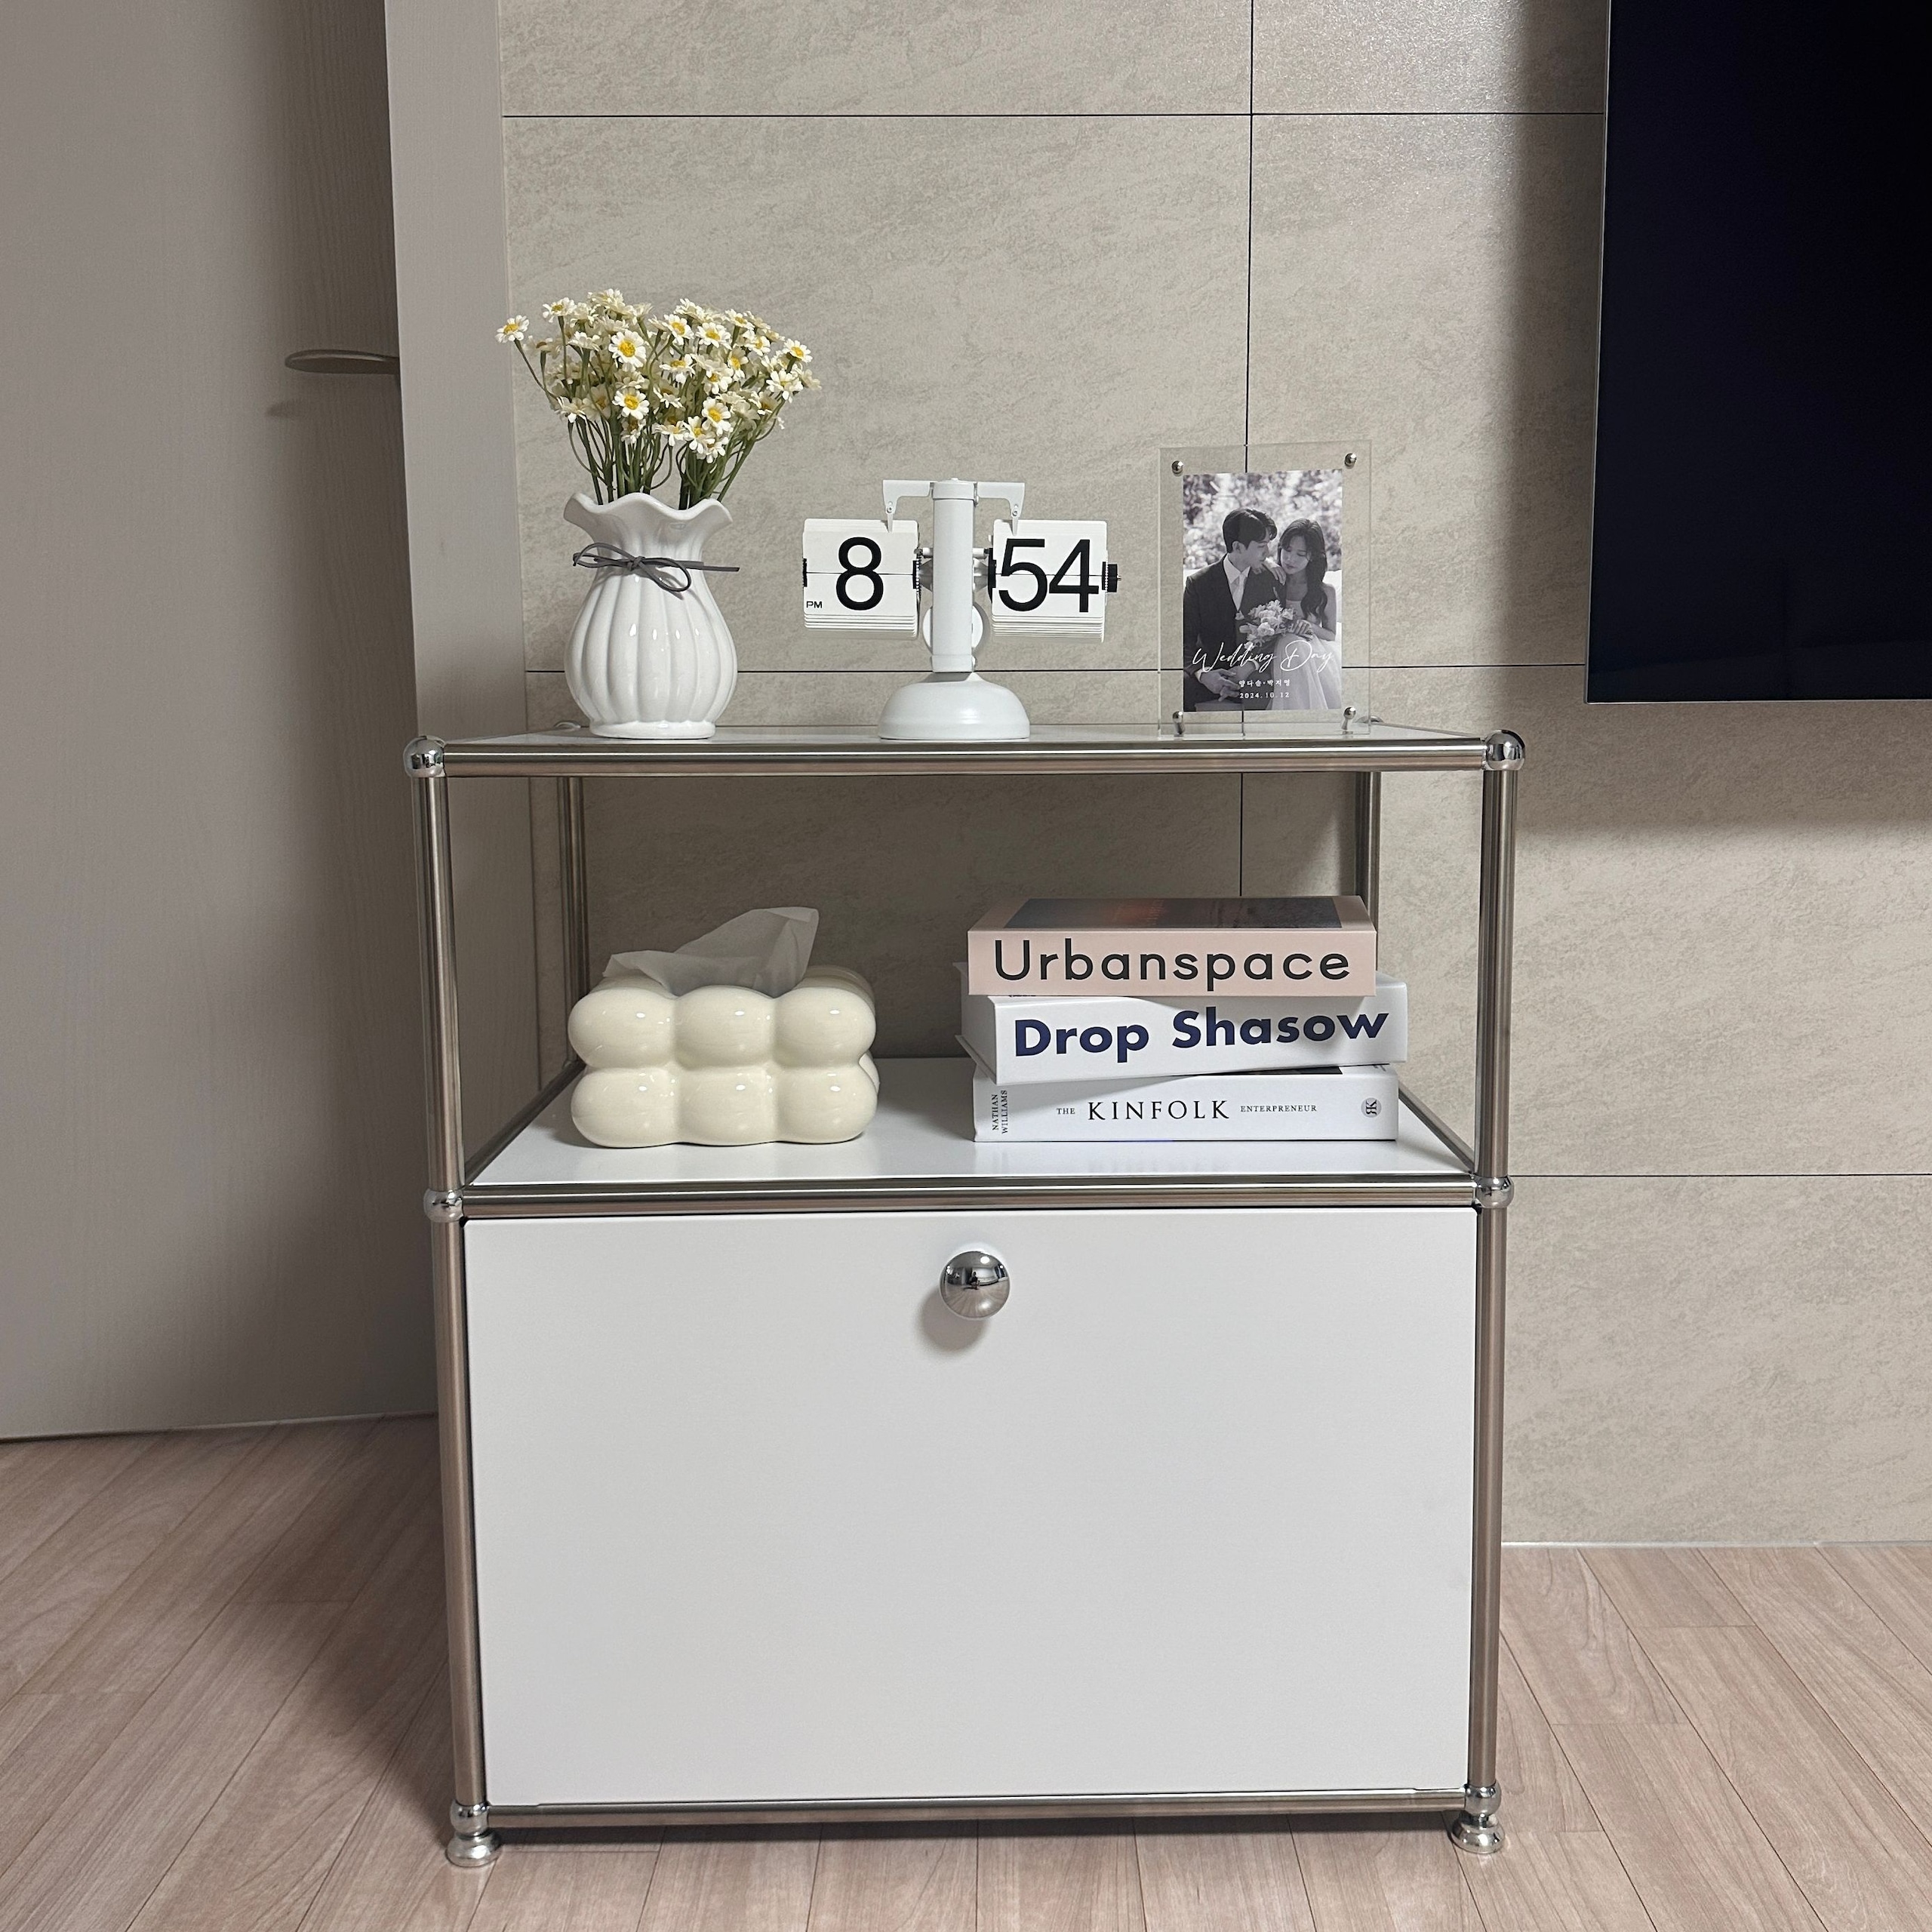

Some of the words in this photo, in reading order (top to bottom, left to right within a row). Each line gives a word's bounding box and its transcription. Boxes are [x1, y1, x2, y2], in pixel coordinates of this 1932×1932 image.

[836, 537, 883, 611] 8
[998, 538, 1099, 612] 54
[1192, 642, 1277, 673] Wedding
[1281, 640, 1334, 672] Day
[995, 938, 1350, 991] Urbanspace
[1015, 1020, 1149, 1063] Drop
[1172, 1006, 1389, 1048] Shasow
[1088, 1100, 1229, 1120] KINFOLK
